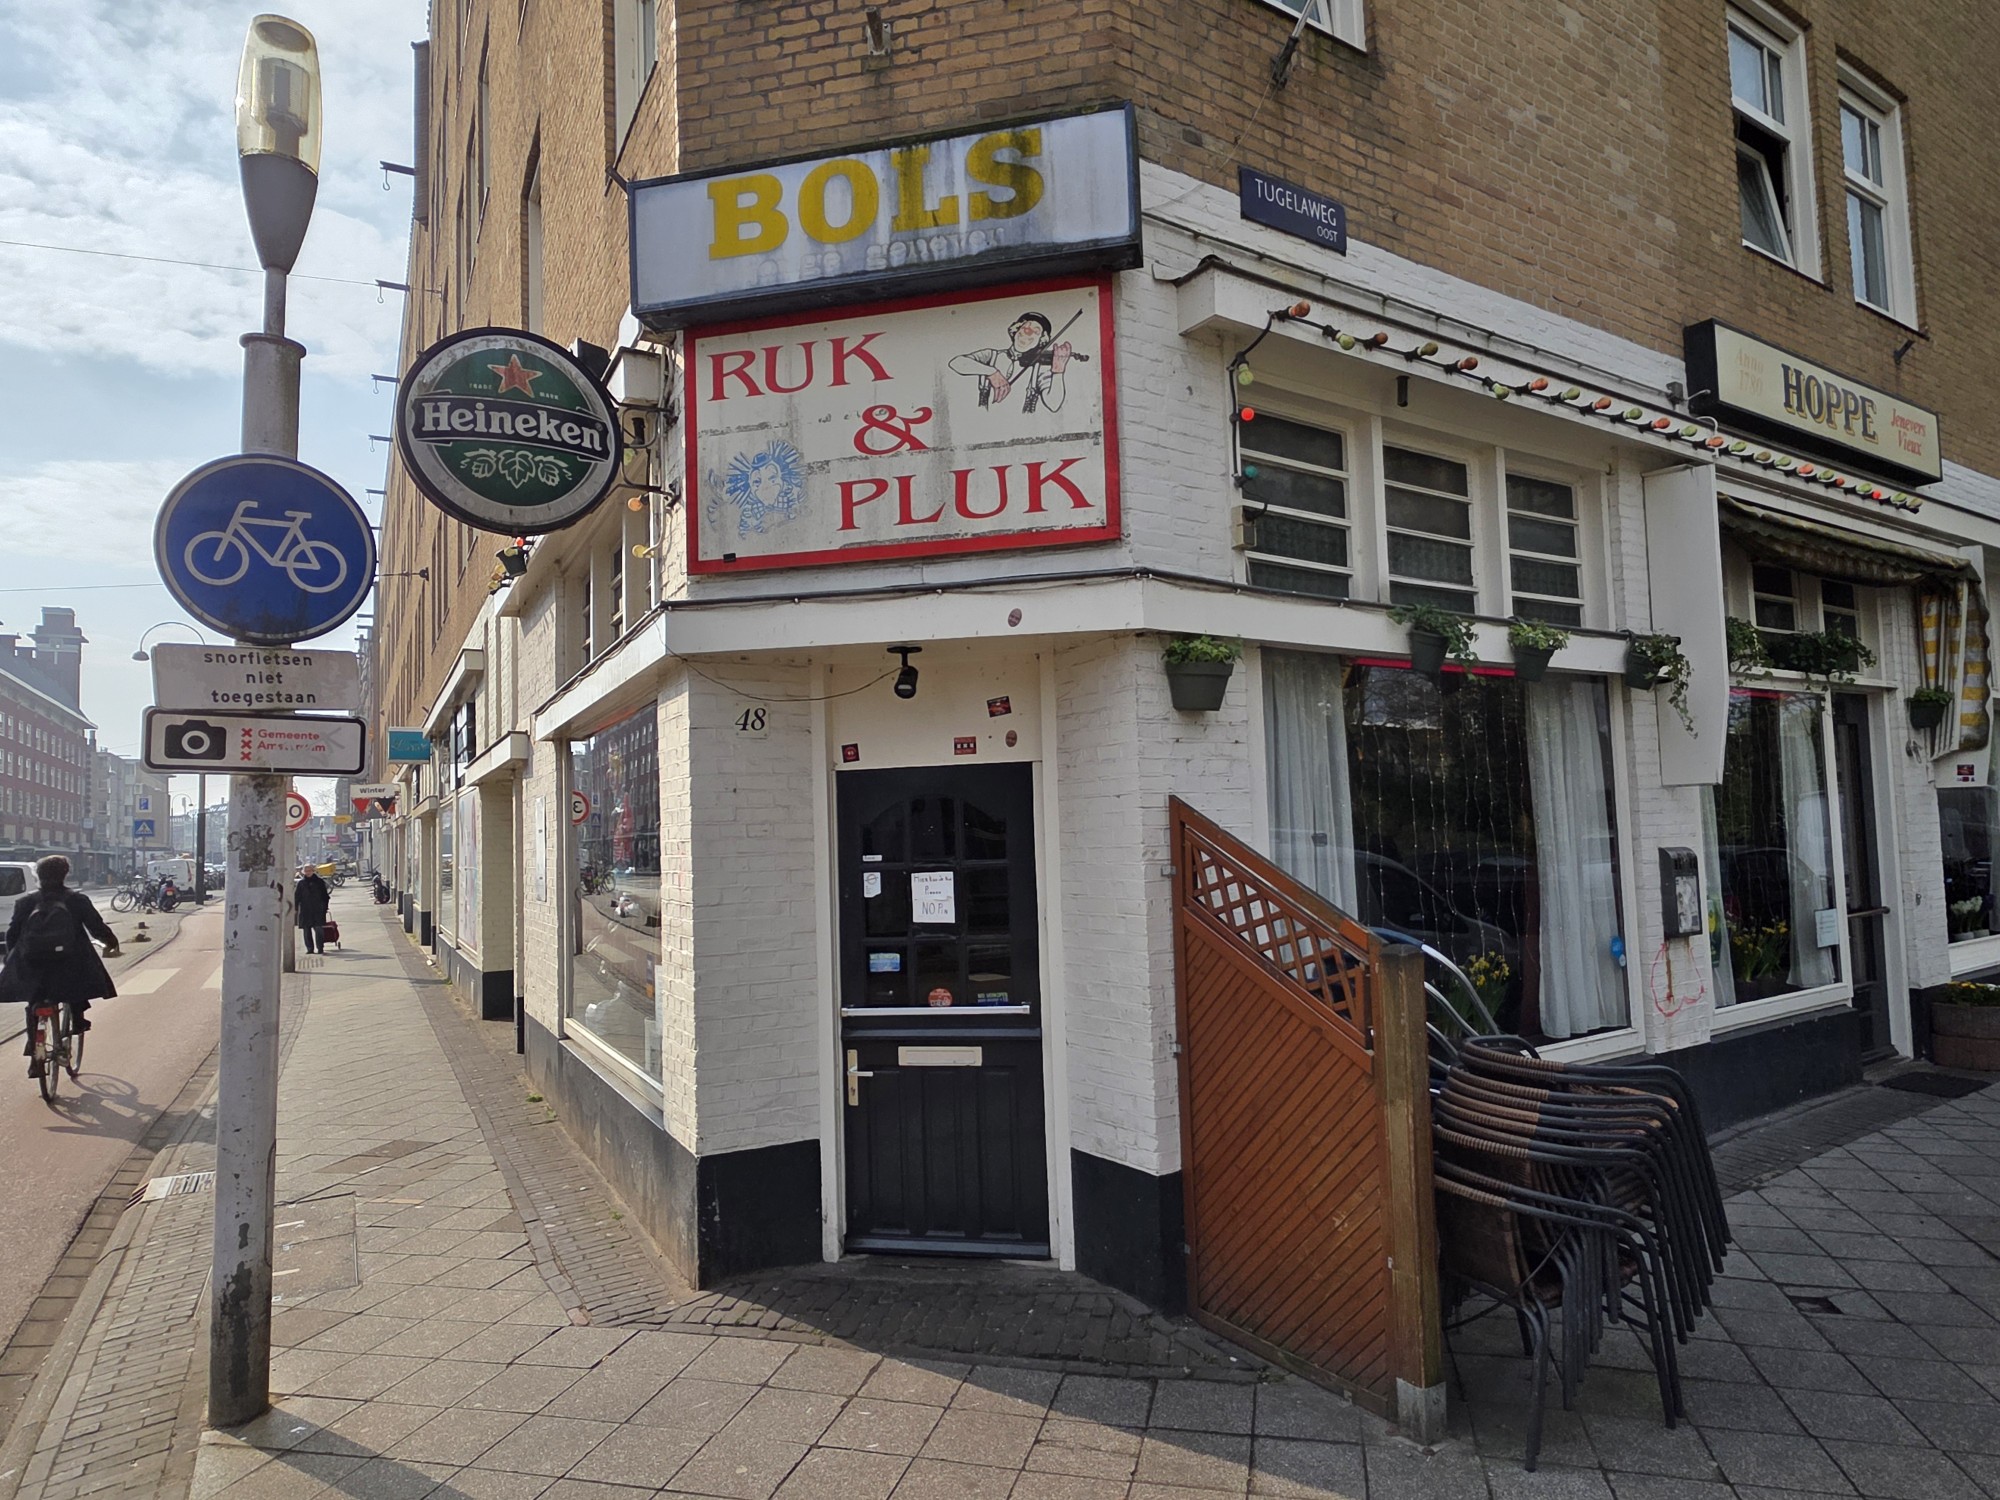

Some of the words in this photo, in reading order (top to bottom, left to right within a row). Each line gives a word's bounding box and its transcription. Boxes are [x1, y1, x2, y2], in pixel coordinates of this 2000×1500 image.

[706, 127, 1045, 261] BOLS
[1254, 178, 1337, 227] TUGELAWEG
[1316, 225, 1338, 243] OOST
[706, 331, 894, 402] RUK
[539, 391, 559, 400] MARK
[1781, 363, 1879, 445] HOPPE
[421, 402, 603, 451] Heineken
[853, 404, 933, 456] &
[835, 457, 1096, 532] PLUK
[204, 652, 313, 667] snorfietsen
[246, 671, 283, 685] niet
[211, 689, 317, 708] toegestaan
[735, 707, 767, 731] 48
[258, 729, 320, 741] Gemeente
[257, 740, 326, 752] Amsrm
[359, 786, 386, 794] Winter
